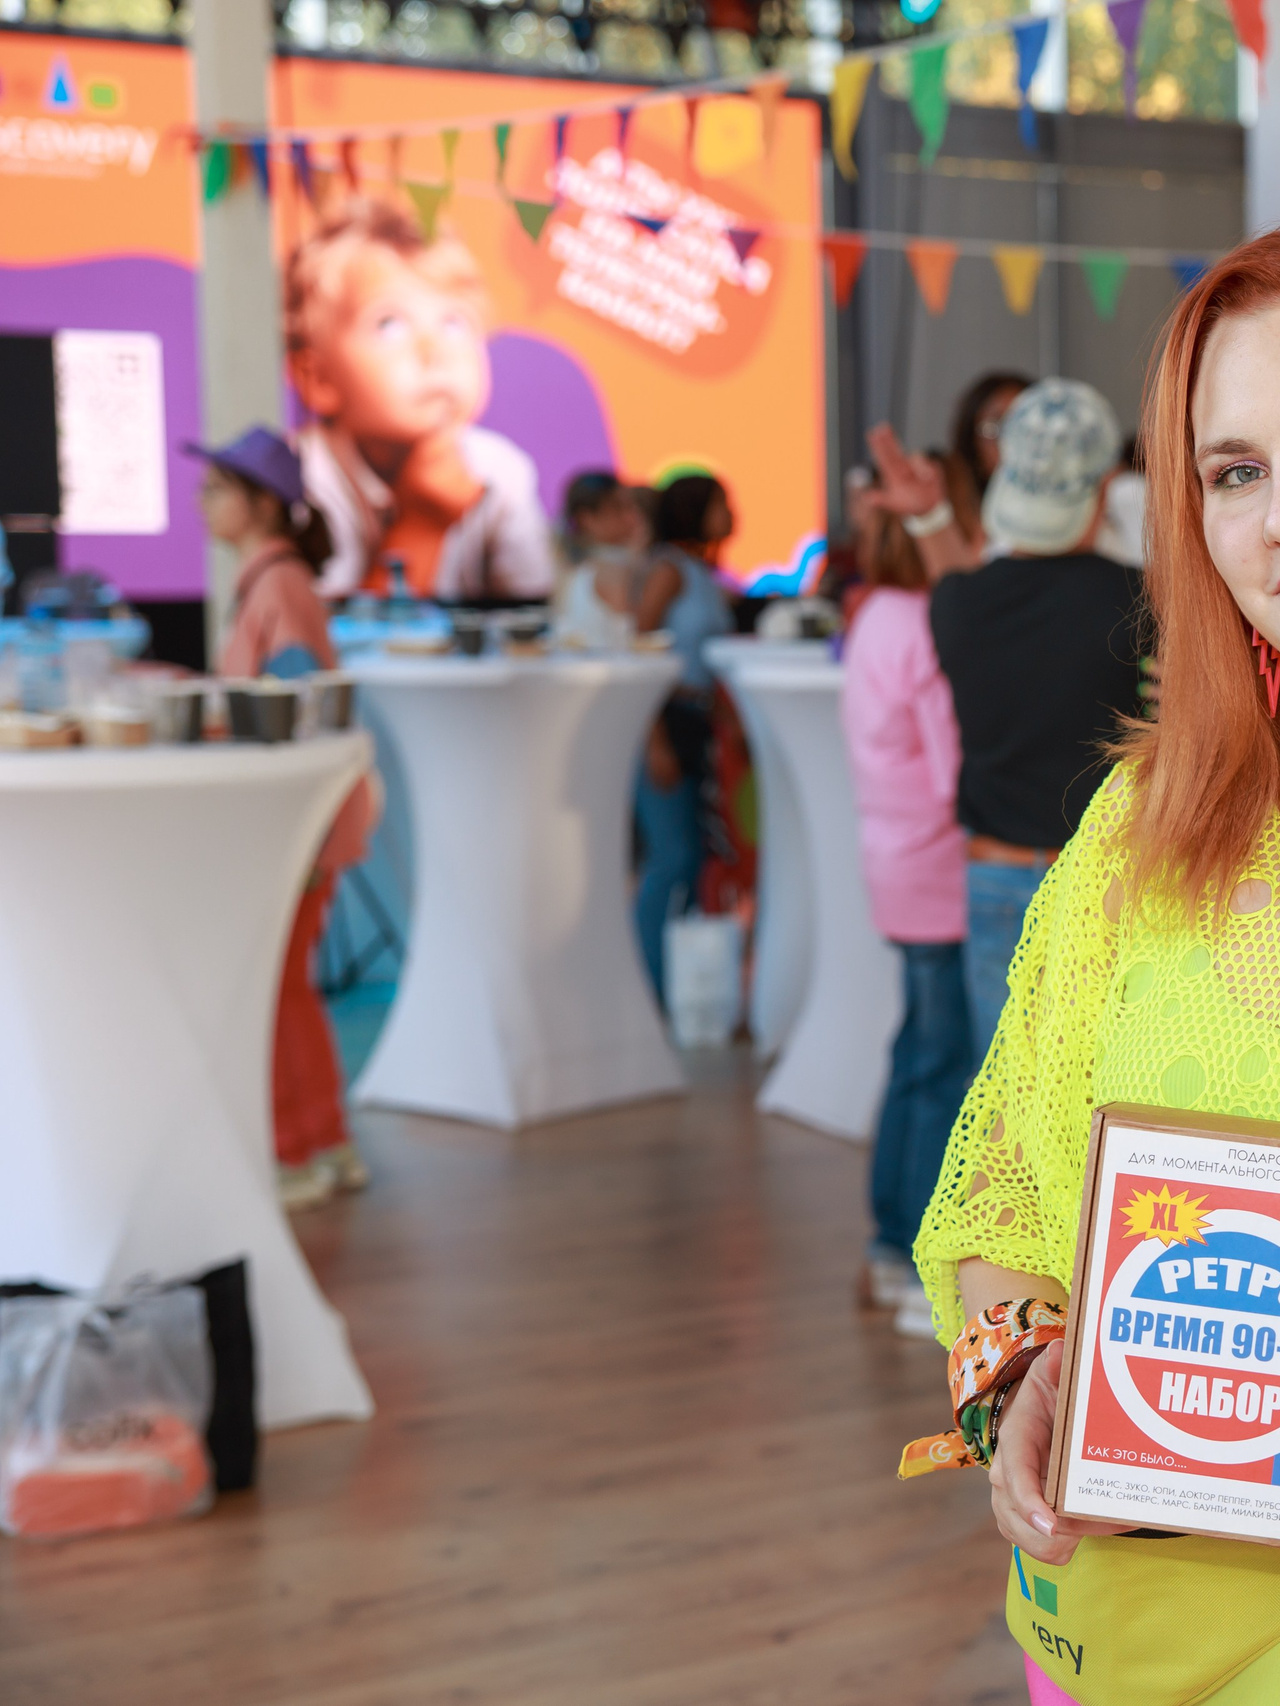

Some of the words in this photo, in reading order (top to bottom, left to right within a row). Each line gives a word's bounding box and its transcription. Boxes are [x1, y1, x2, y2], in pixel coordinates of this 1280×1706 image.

[1128, 1152, 1156, 1166] ДЛЯ
[1150, 1201, 1179, 1232] XL
[1108, 1306, 1225, 1356] ВРЕМЯ
[1087, 1445, 1110, 1459] КАК
[1112, 1448, 1138, 1462] ЭТО
[1086, 1477, 1104, 1487] ЛАВ
[1179, 1490, 1216, 1502] ДОКТОР
[1231, 1508, 1264, 1519] МИЛКИ
[1032, 1620, 1074, 1676] ery
